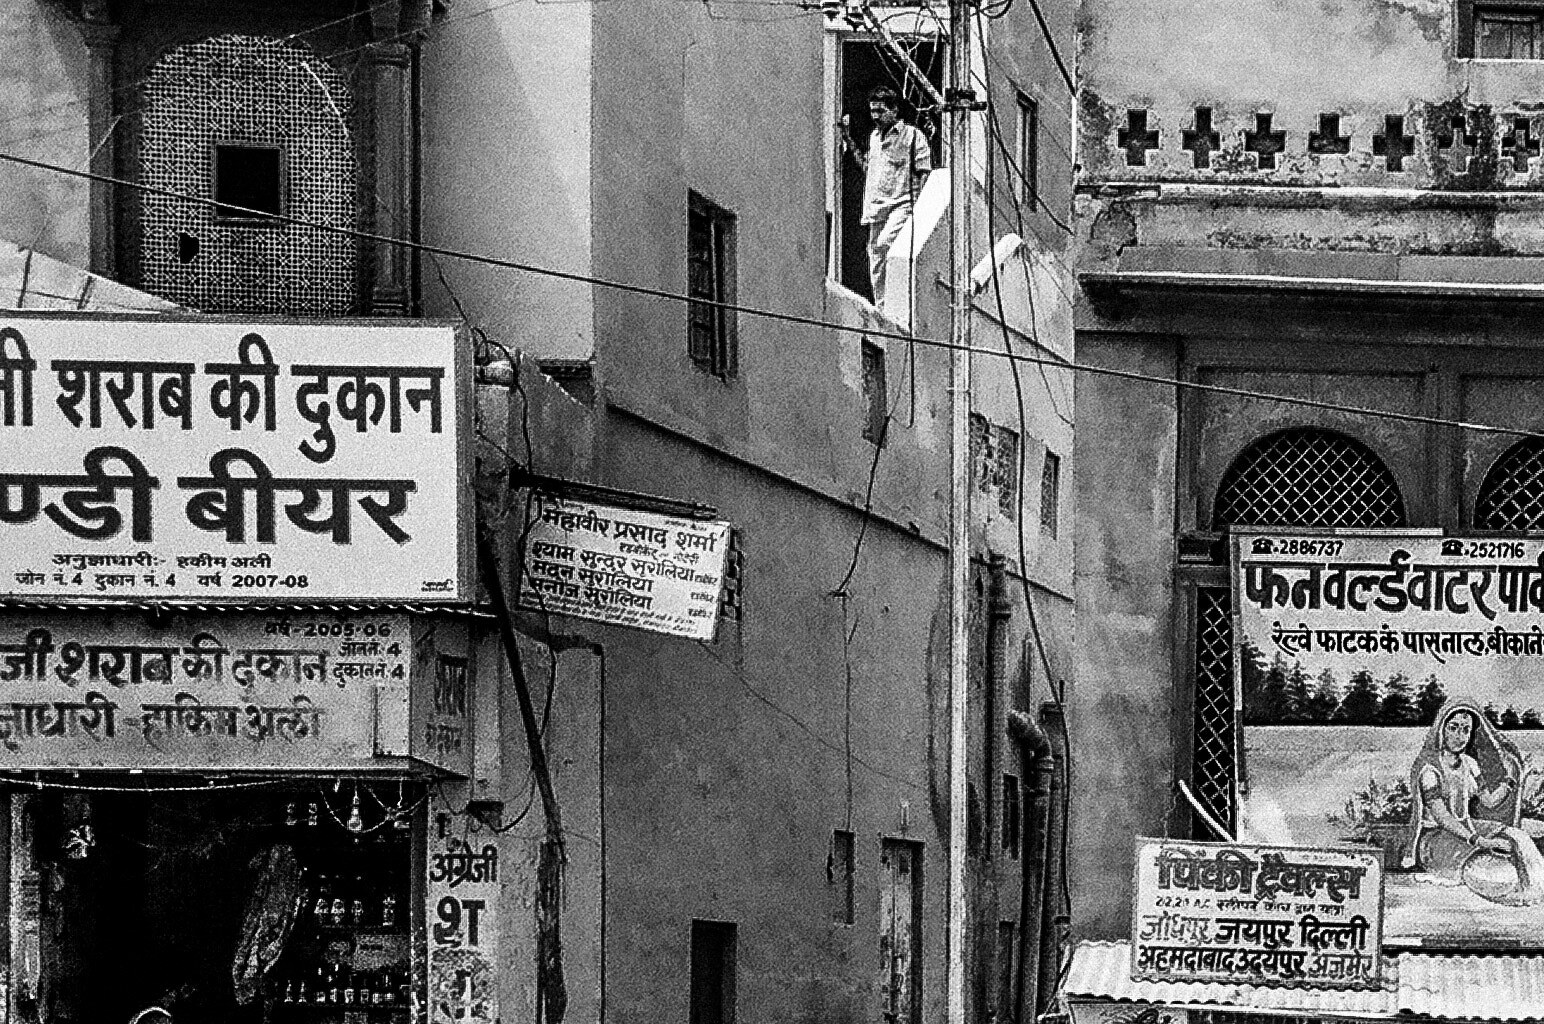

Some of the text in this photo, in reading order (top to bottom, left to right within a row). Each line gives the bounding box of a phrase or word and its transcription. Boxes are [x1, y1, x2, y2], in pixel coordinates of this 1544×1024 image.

[51, 358, 196, 431] शराब
[204, 332, 280, 432] की
[291, 364, 445, 463] दुकान
[177, 448, 417, 546] बीयर
[542, 506, 611, 537] महावीर
[613, 520, 668, 549] प्रसाद
[675, 531, 718, 552] शर्मा
[72, 573, 83, 587] 4
[95, 573, 136, 591] दुकान
[165, 573, 176, 587] 4
[198, 570, 222, 588] वर्ष
[231, 573, 309, 589] 2007-08
[231, 552, 272, 570] अली
[55, 642, 178, 687] शराब
[182, 632, 230, 682] की
[1214, 917, 1295, 950] जयपुर
[1298, 913, 1371, 951] दिल्ली
